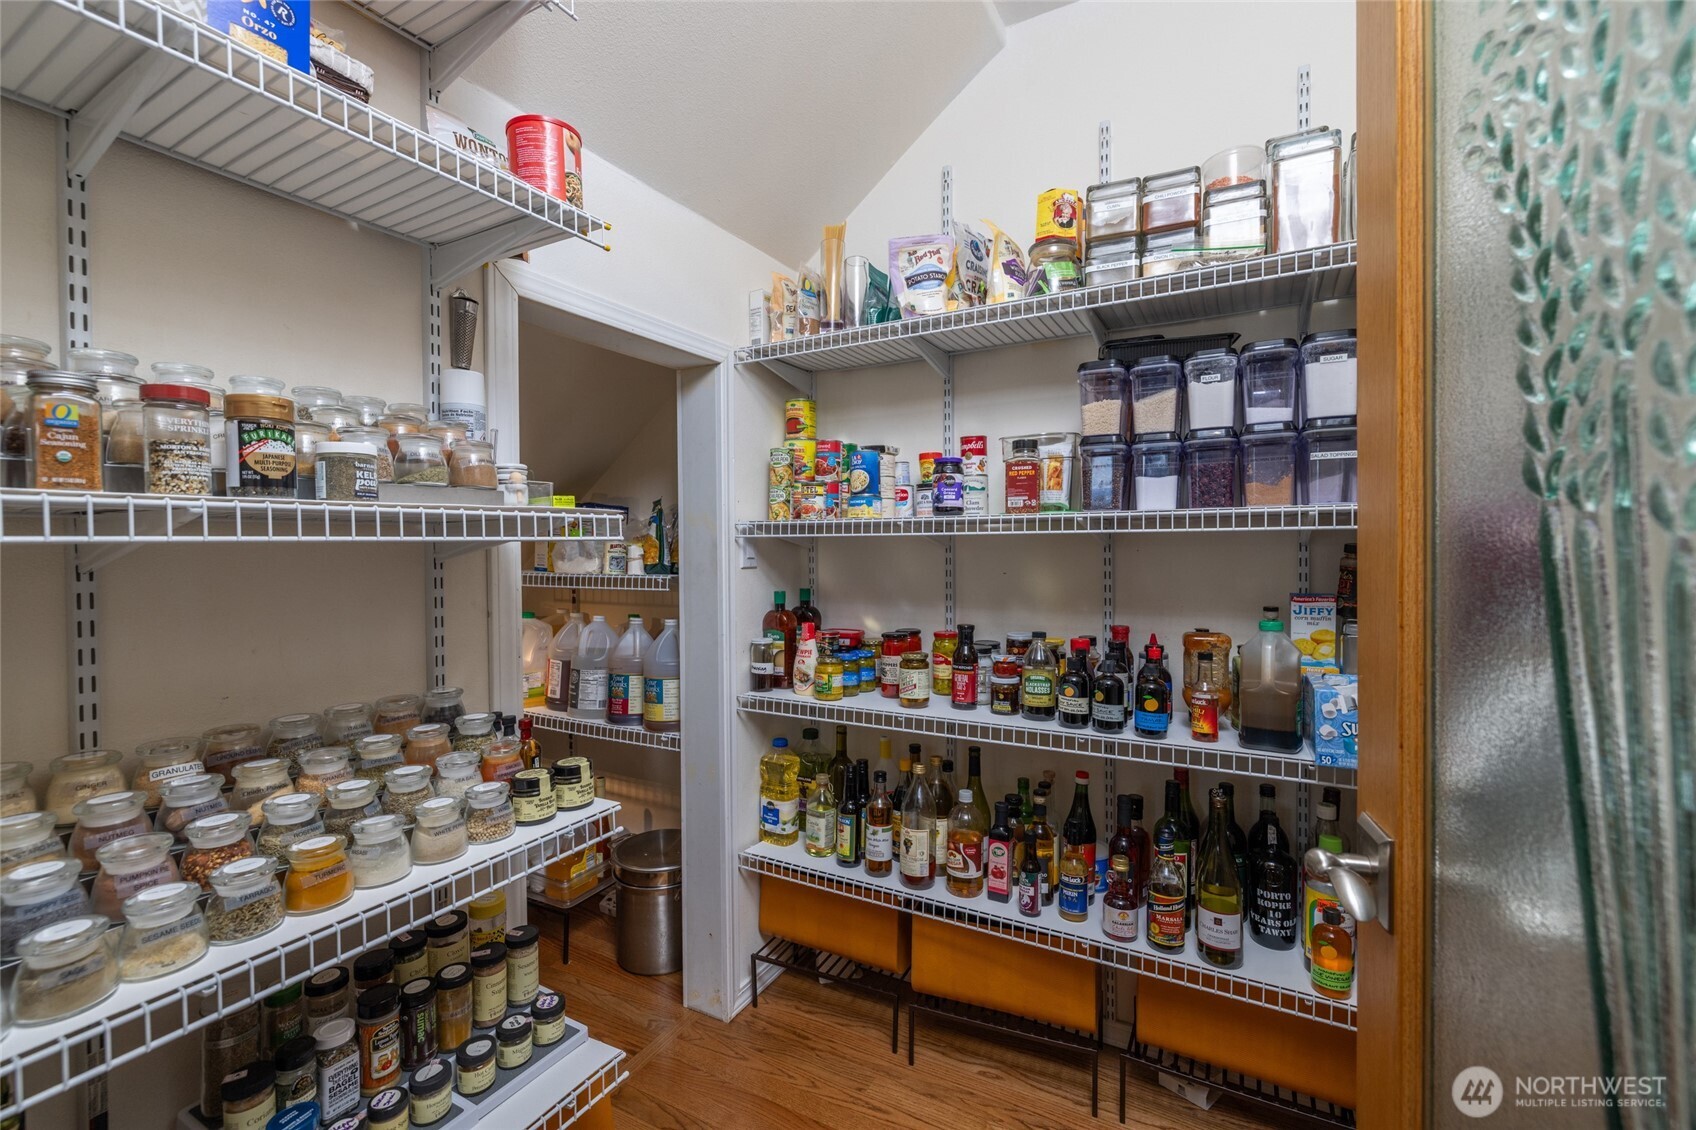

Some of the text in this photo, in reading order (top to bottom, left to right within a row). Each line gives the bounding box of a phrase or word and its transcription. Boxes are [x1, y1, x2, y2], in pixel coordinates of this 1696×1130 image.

[241, 16, 278, 40] Orzo
[46, 432, 79, 442] Cajun
[40, 440, 87, 449] Seasoning
[1321, 756, 1331, 764] 50
[75, 780, 107, 792] GINGER
[98, 829, 135, 844] NUTMEG
[434, 827, 452, 837] WHITE
[119, 869, 159, 883] PUMPKIN
[134, 878, 159, 891] SPICE
[1257, 888, 1291, 900] PORTO
[1257, 898, 1292, 910] KOPKE
[1250, 911, 1281, 928] YEARS
[1269, 910, 1282, 918] 10
[141, 927, 178, 943] SESAME
[1259, 925, 1292, 937] TAWNY
[417, 1012, 425, 1043] sumac
[328, 1061, 358, 1082] EVERYTHING
[328, 1080, 359, 1100] SESAME
[329, 1075, 359, 1094] BAGEL
